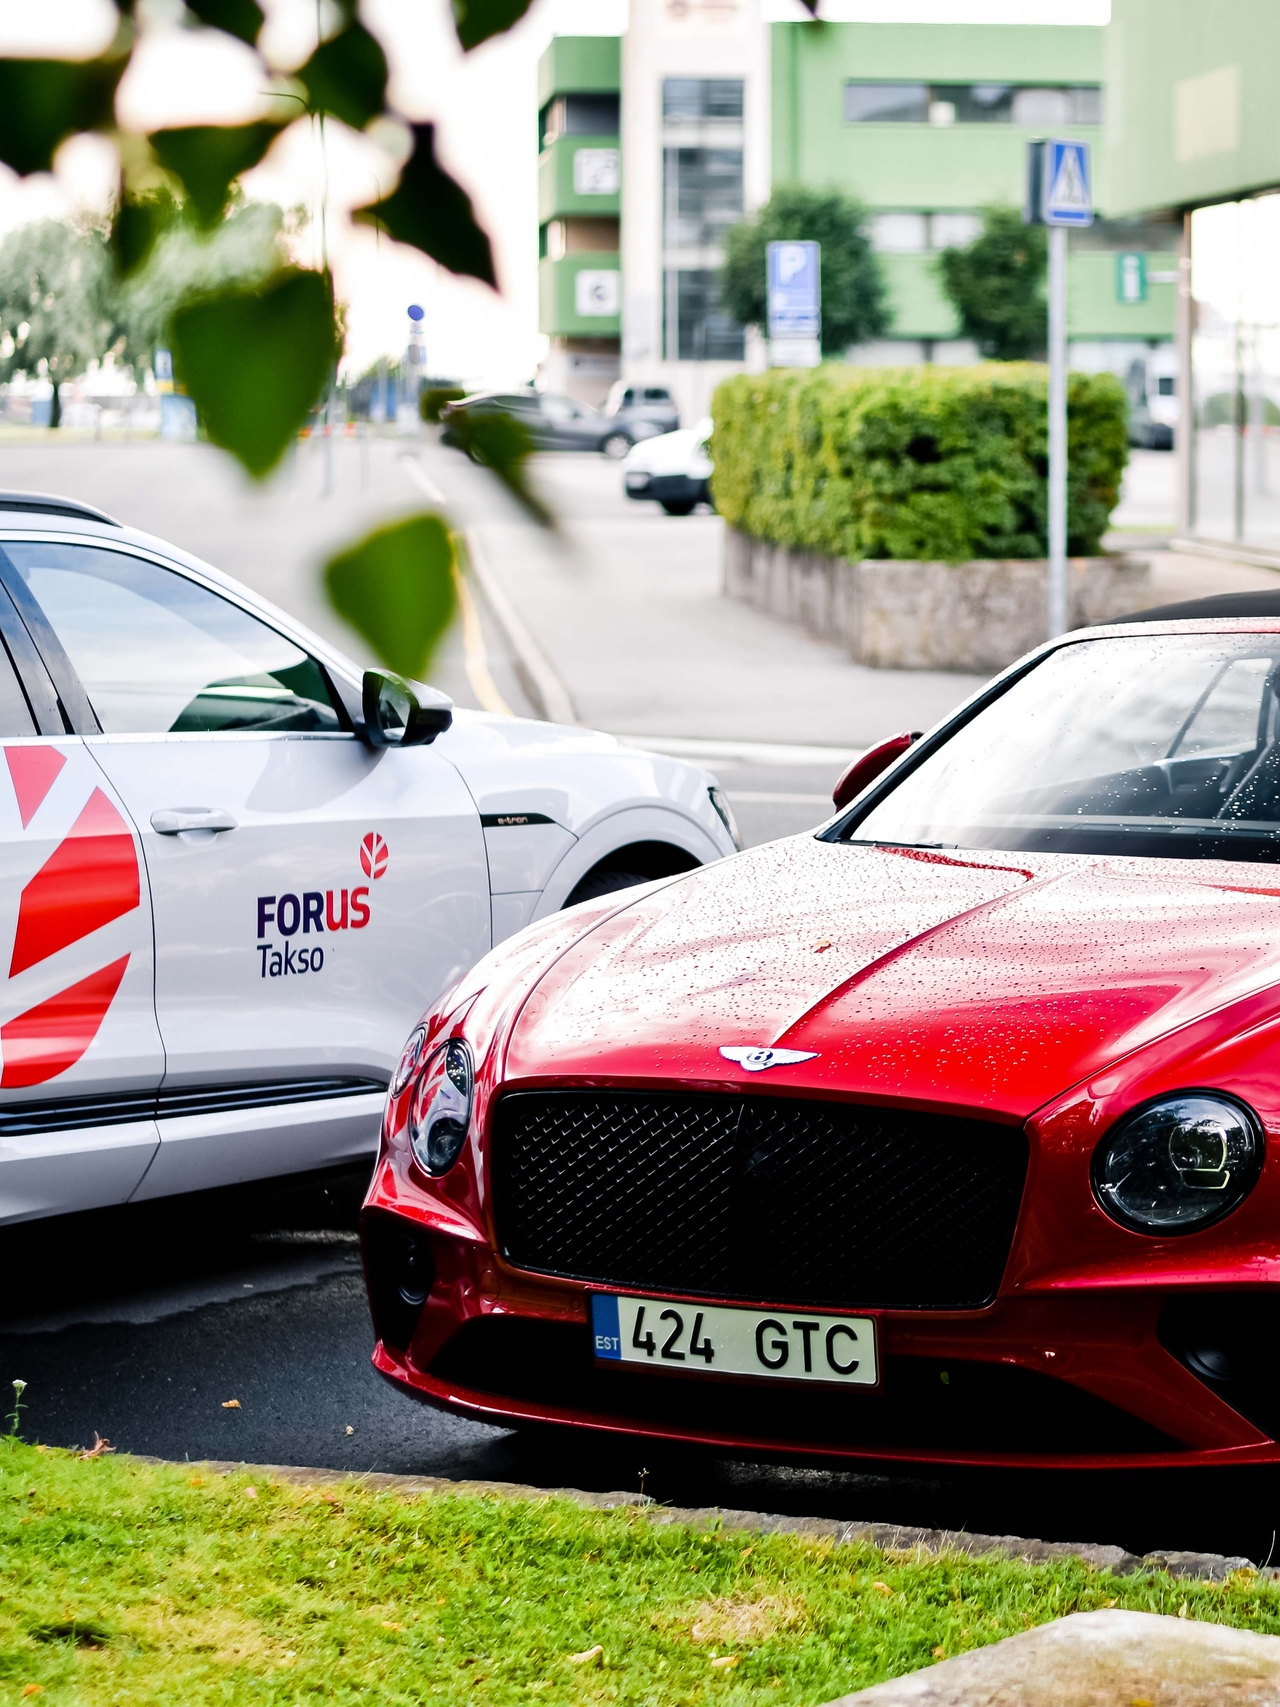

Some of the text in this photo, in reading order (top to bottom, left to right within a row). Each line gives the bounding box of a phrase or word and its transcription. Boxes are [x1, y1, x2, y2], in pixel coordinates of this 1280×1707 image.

[497, 816, 528, 825] e-tron
[257, 886, 371, 939] FORUS
[256, 940, 325, 978] Takso
[595, 1305, 861, 1376] EST 424 GTC
